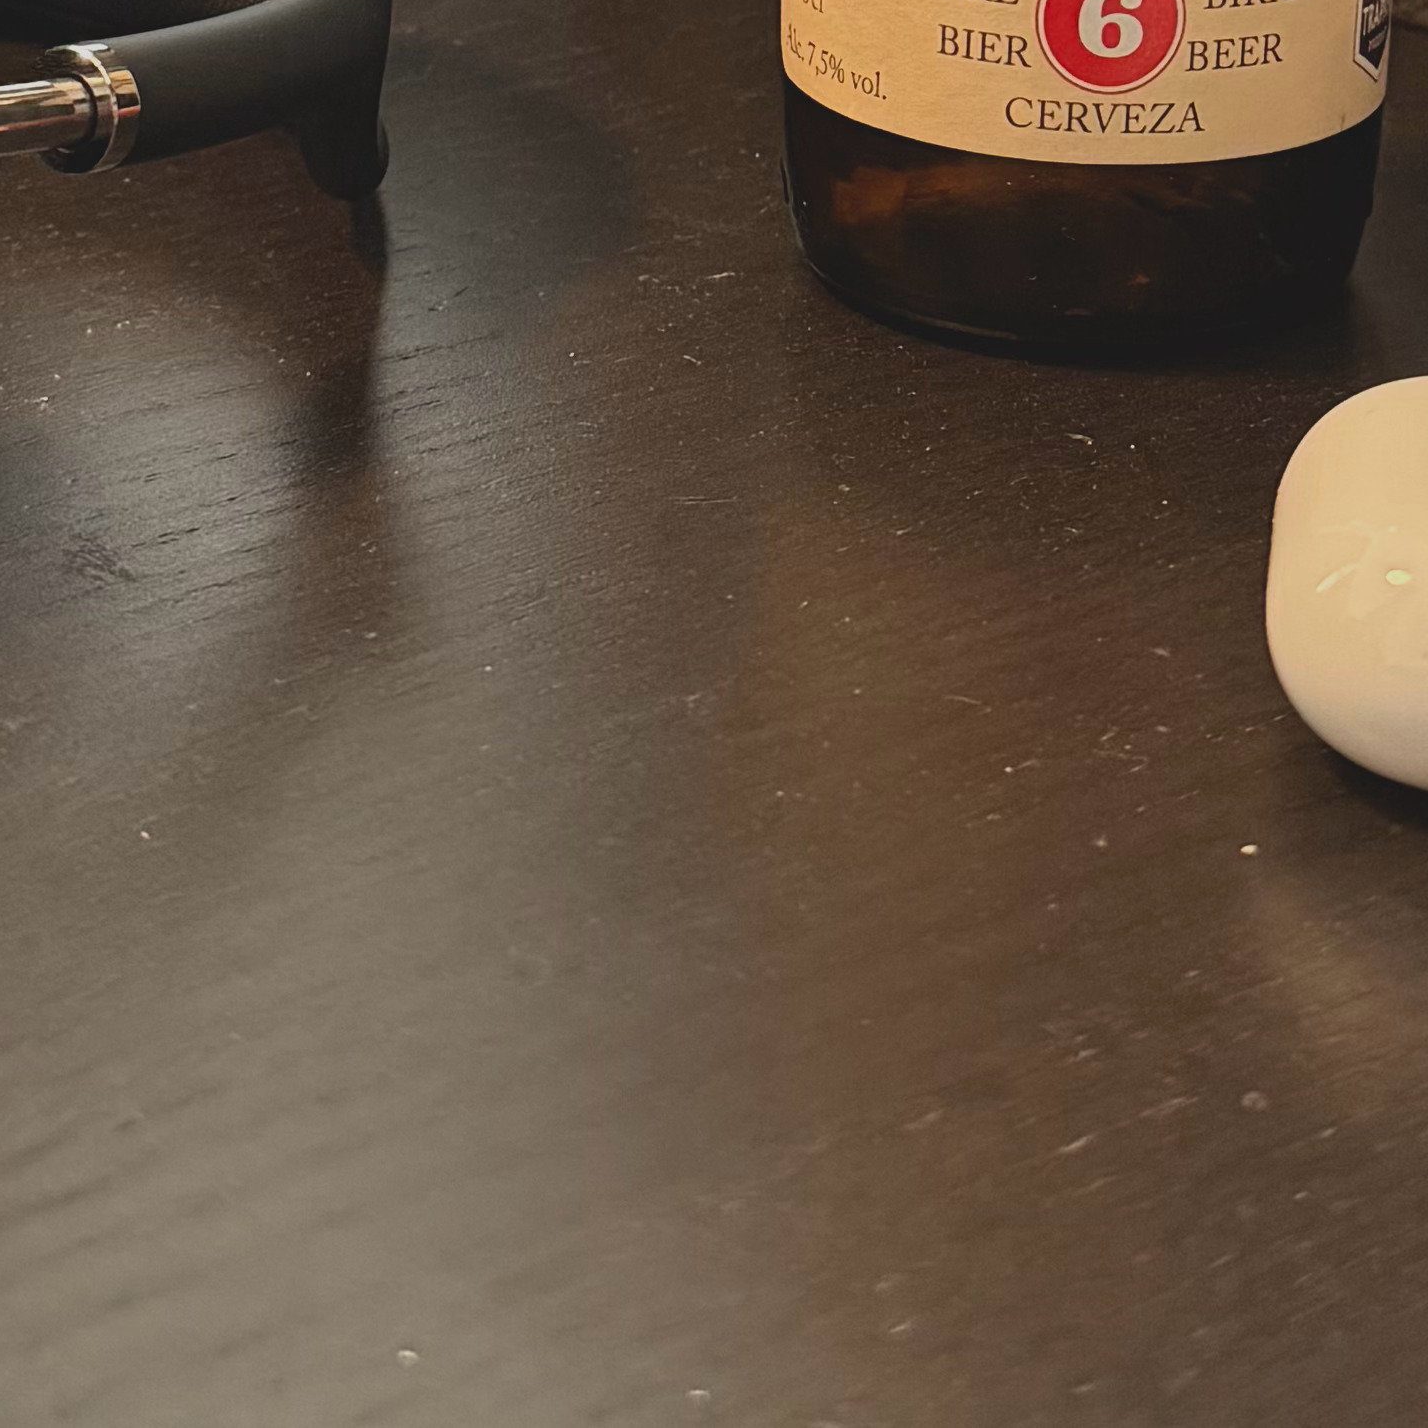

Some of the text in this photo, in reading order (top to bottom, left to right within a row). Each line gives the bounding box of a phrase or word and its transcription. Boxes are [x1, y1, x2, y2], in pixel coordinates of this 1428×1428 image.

[936, 24, 1032, 68] BIER
[1185, 32, 1284, 74] BEER
[808, 41, 845, 84] 7,5%
[851, 70, 887, 100] vol.
[1005, 98, 1206, 135] CERVEZA
